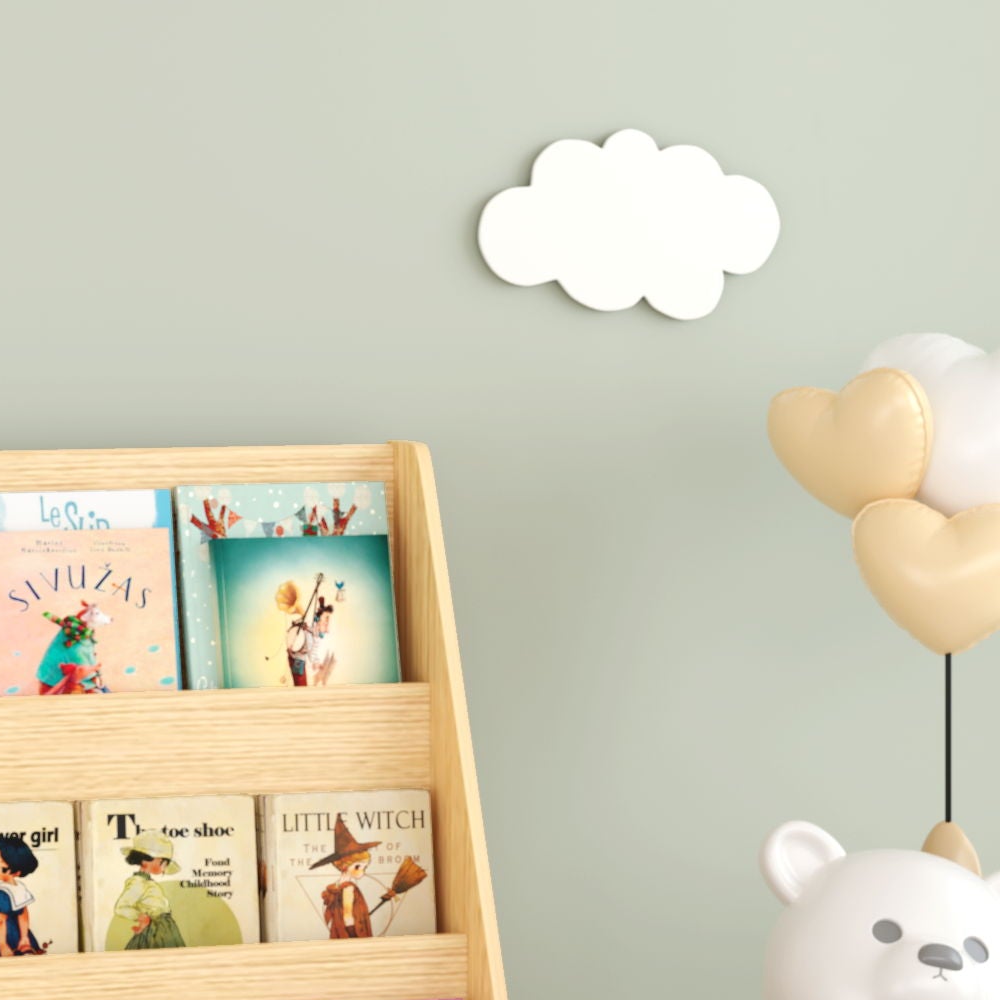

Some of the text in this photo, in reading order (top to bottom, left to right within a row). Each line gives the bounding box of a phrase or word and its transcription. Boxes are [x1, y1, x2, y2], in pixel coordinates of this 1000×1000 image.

[39, 495, 61, 528] Le
[8, 562, 152, 612] SIVUŽAS
[356, 810, 426, 830] WITCH
[193, 822, 235, 838] shoe
[30, 827, 59, 848] girl
[304, 844, 327, 853] THE
[204, 858, 230, 867] Fond
[192, 869, 232, 878] Memory
[179, 879, 231, 888] Childhood
[206, 890, 233, 899] Story
